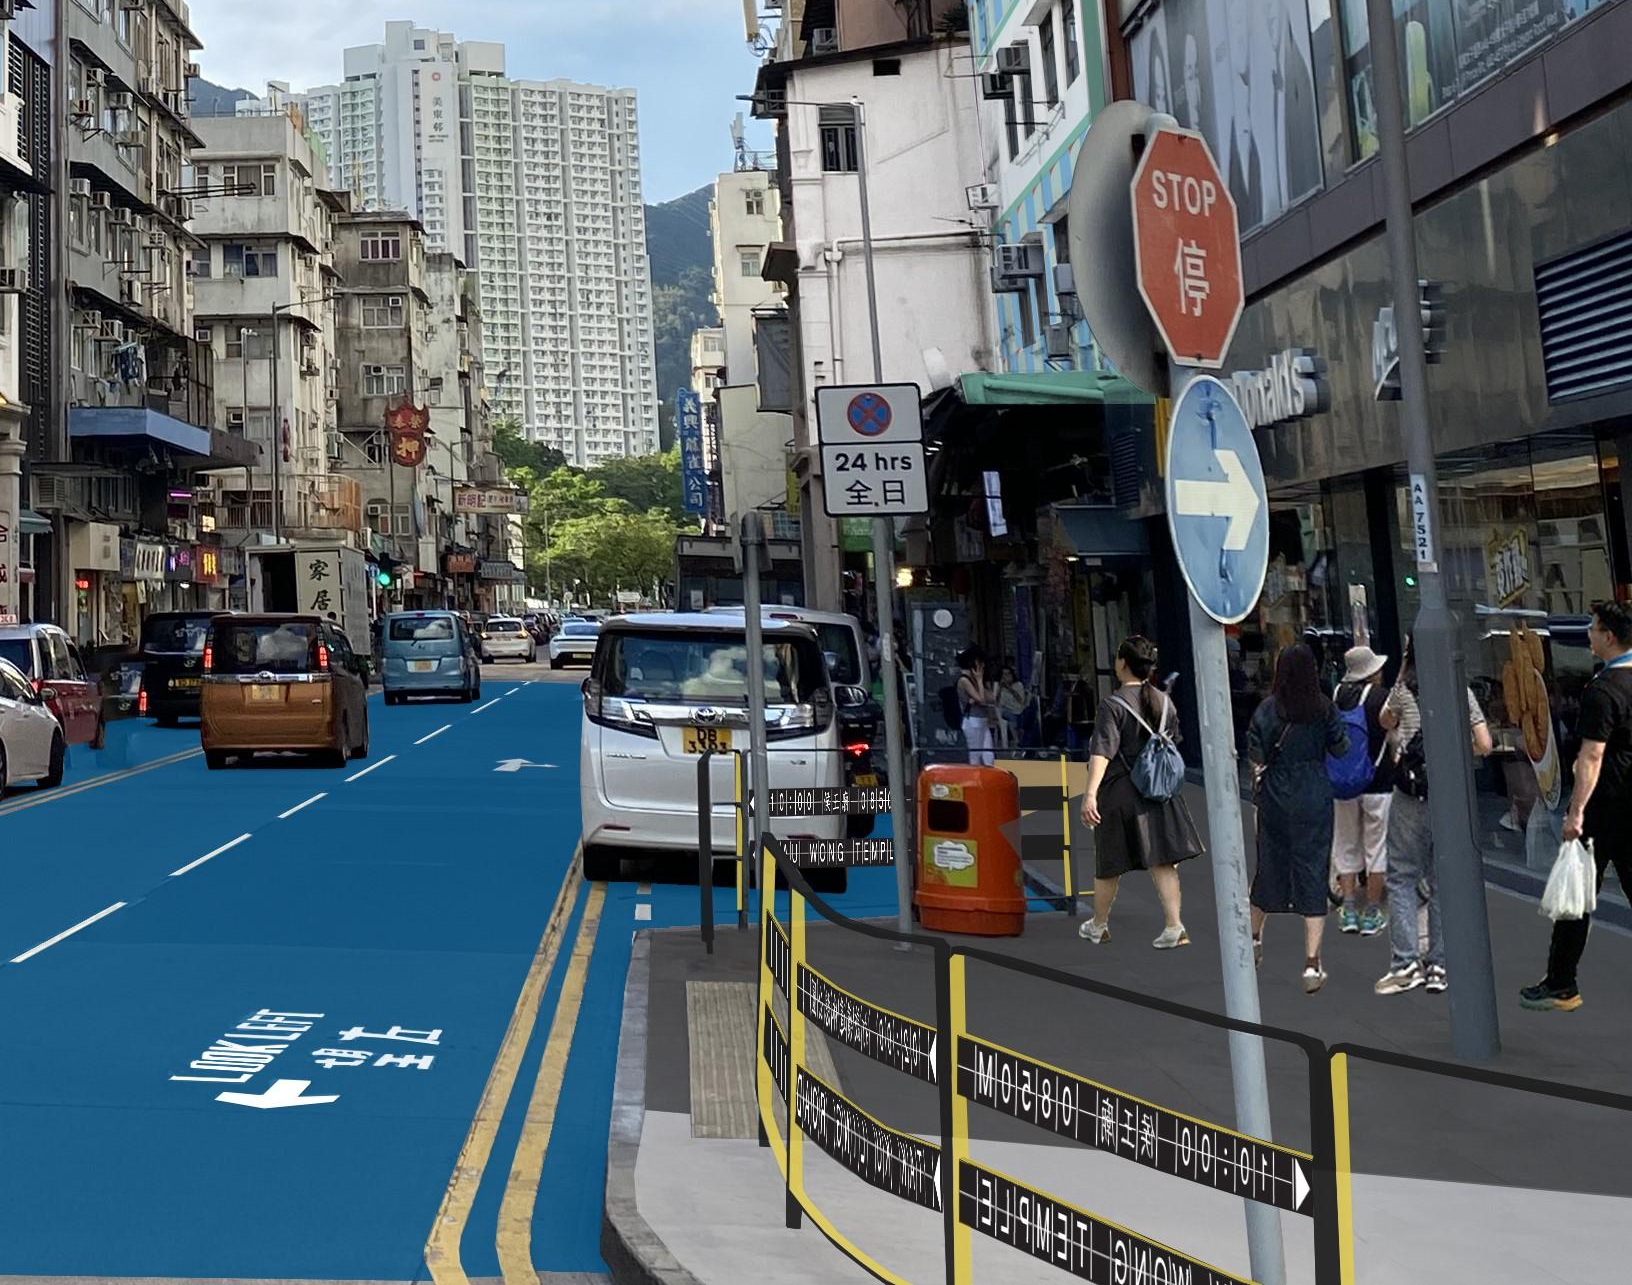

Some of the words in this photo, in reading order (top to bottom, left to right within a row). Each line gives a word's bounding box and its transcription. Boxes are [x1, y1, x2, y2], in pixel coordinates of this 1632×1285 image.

[1152, 170, 1216, 217] STOP
[1174, 237, 1210, 316] 停
[835, 453, 867, 472] 24
[875, 453, 912, 470] hrs
[1413, 484, 1423, 505] AA
[1416, 513, 1428, 559] 7521
[309, 559, 331, 611] 家居
[697, 728, 717, 741] DB
[770, 792, 812, 812] 10:00
[861, 791, 891, 811] 085
[809, 843, 844, 865] WONG
[855, 842, 894, 862] TEMPL
[223, 1009, 325, 1041] LEFT
